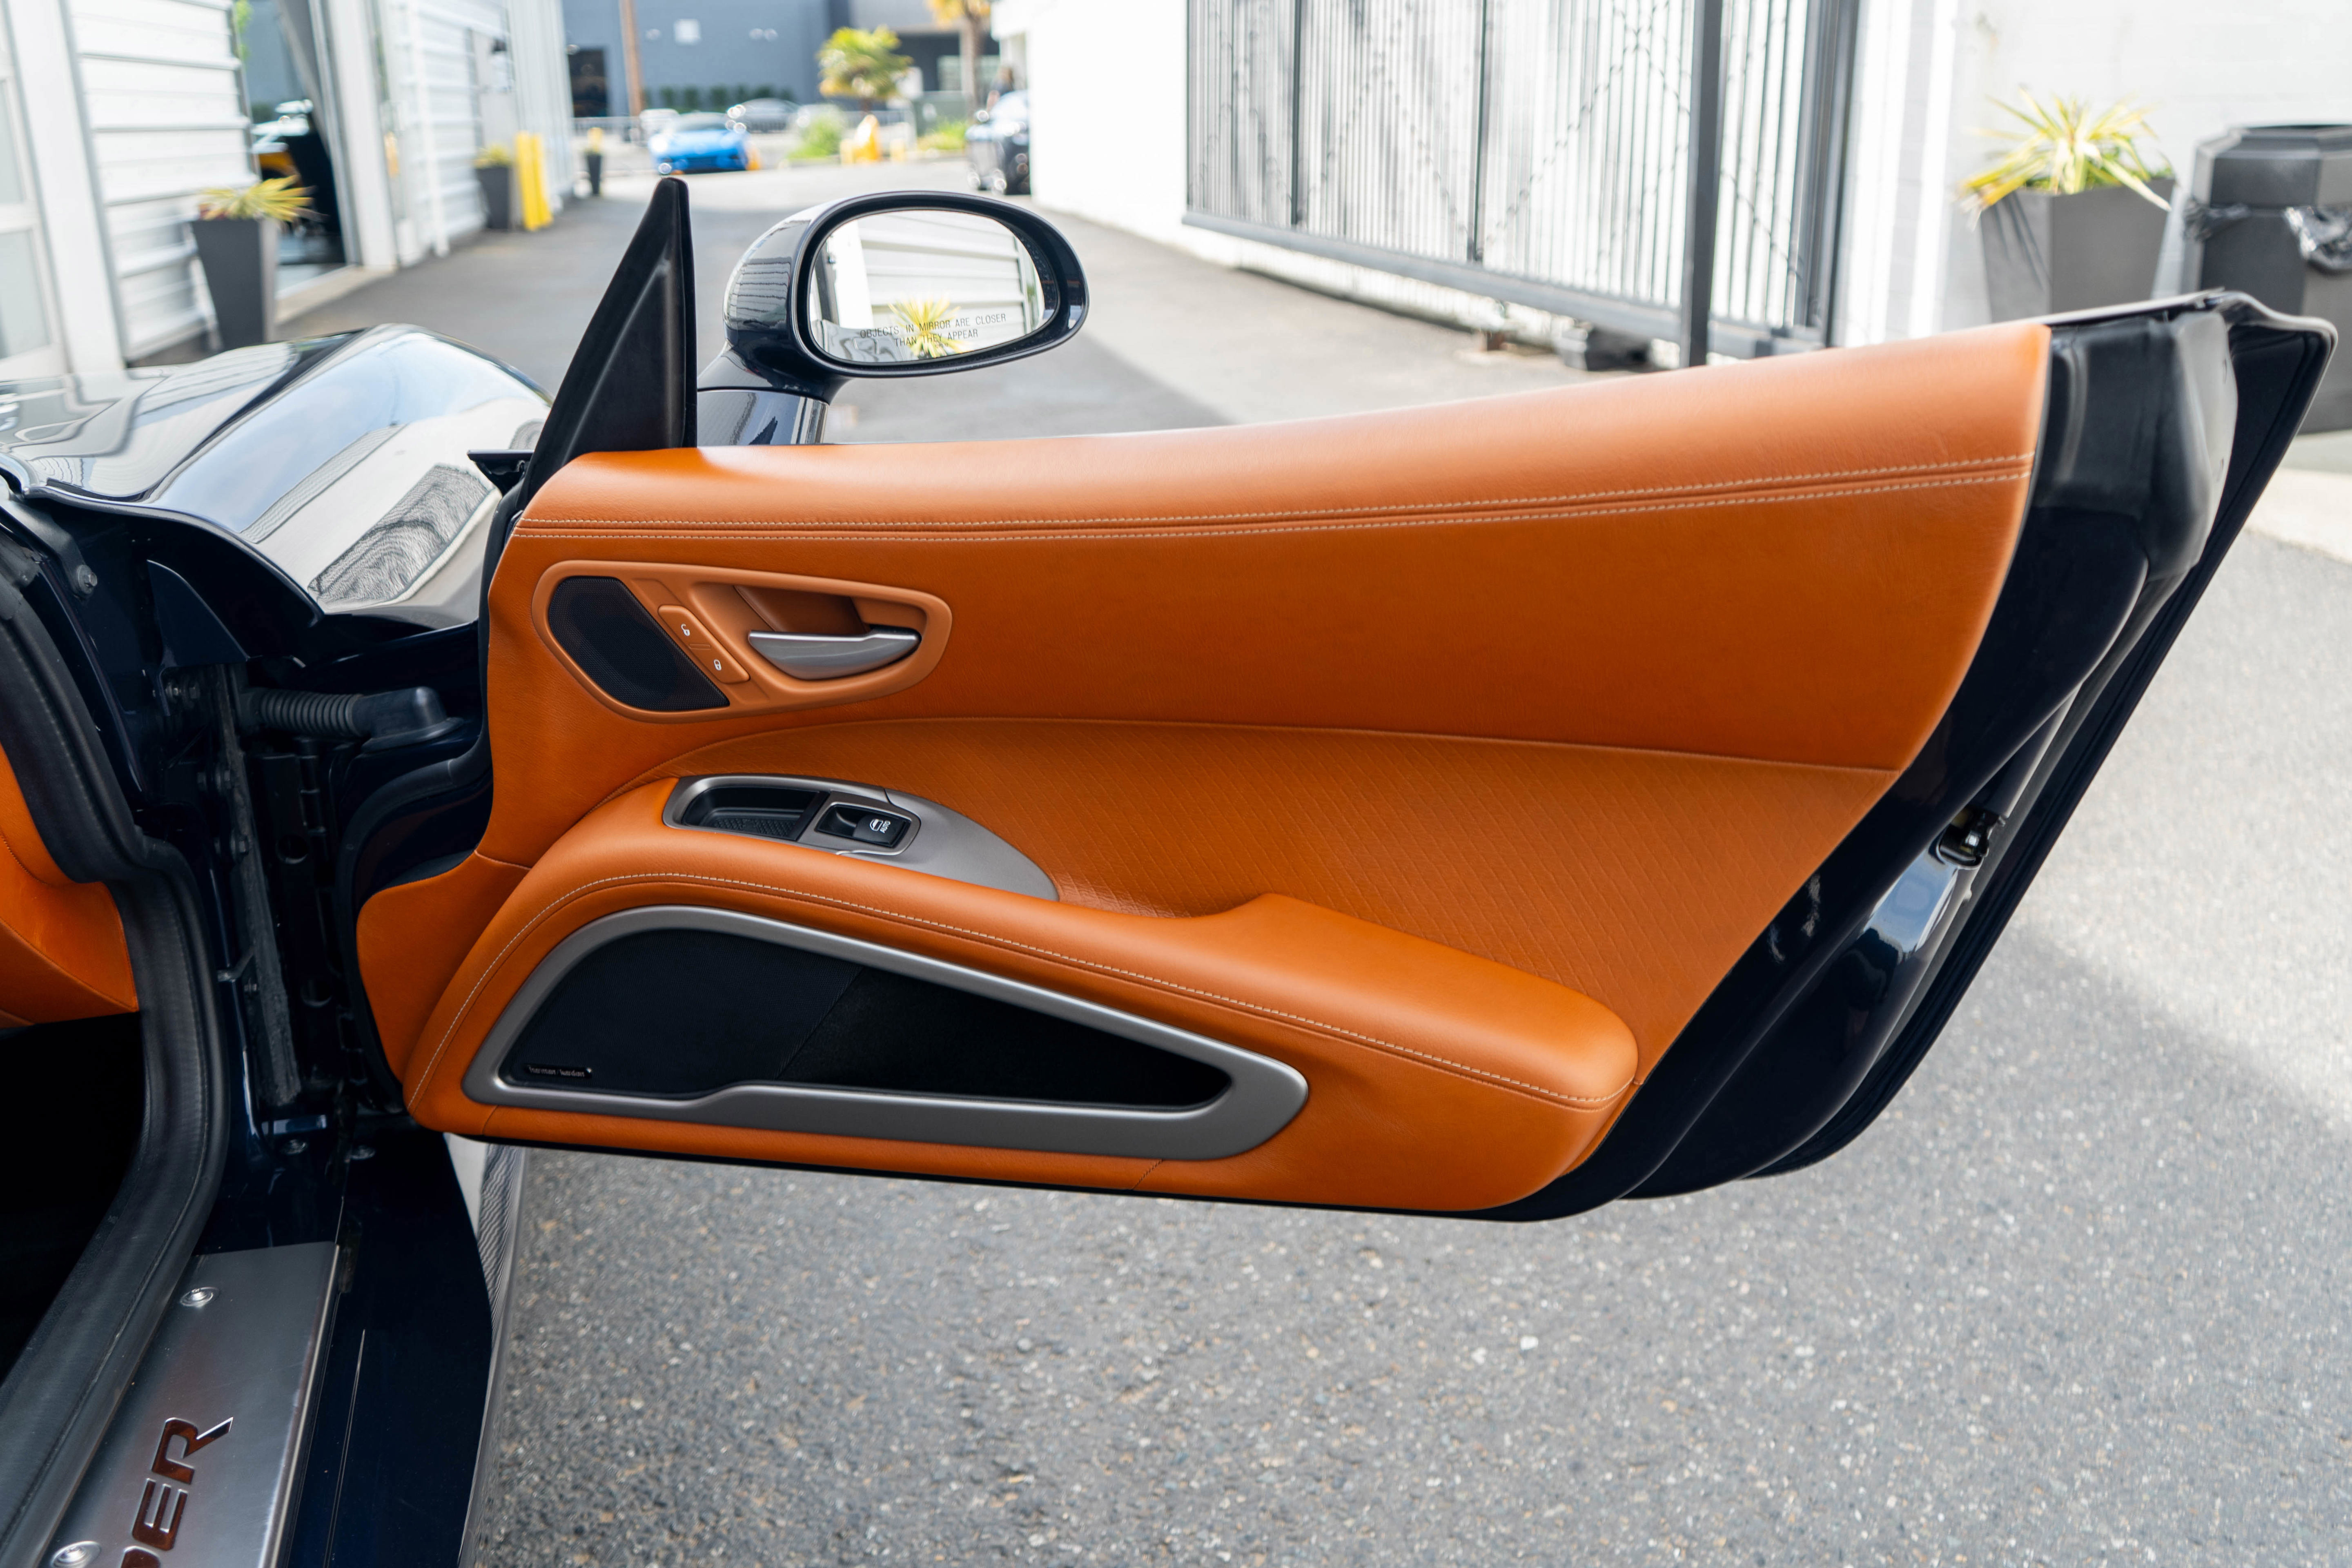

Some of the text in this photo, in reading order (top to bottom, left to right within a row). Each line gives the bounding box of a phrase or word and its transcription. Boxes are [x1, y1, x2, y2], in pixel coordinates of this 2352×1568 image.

[860, 313, 1007, 339] OBJECTS IN MIRROR ARE CLOSER
[895, 329, 978, 347] THAN THEY APPEAR
[880, 820, 891, 833] AUTO
